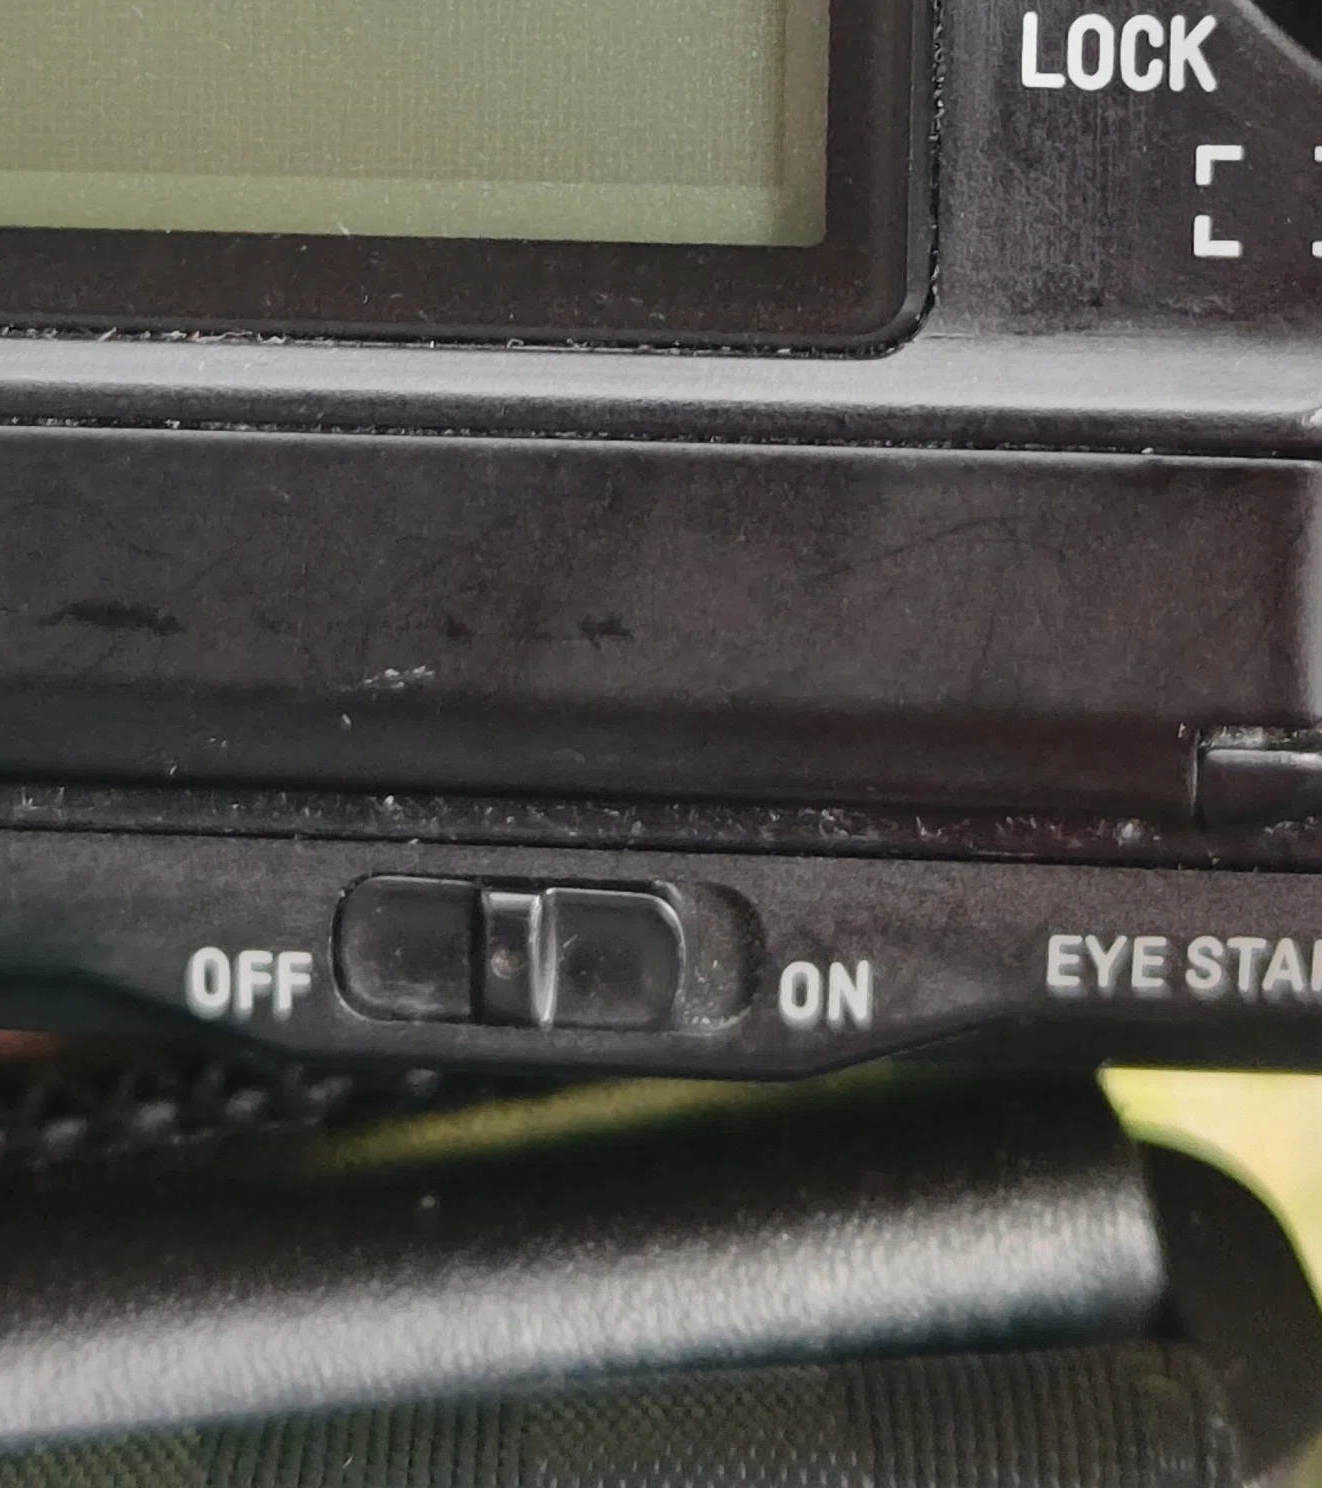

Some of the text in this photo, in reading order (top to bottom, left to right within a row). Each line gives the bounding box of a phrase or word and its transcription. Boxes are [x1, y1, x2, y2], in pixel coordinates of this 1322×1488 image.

[1020, 12, 1218, 93] LOCK
[188, 945, 313, 1016] OFF
[779, 961, 871, 1023] ON
[1046, 935, 1168, 989] EYE
